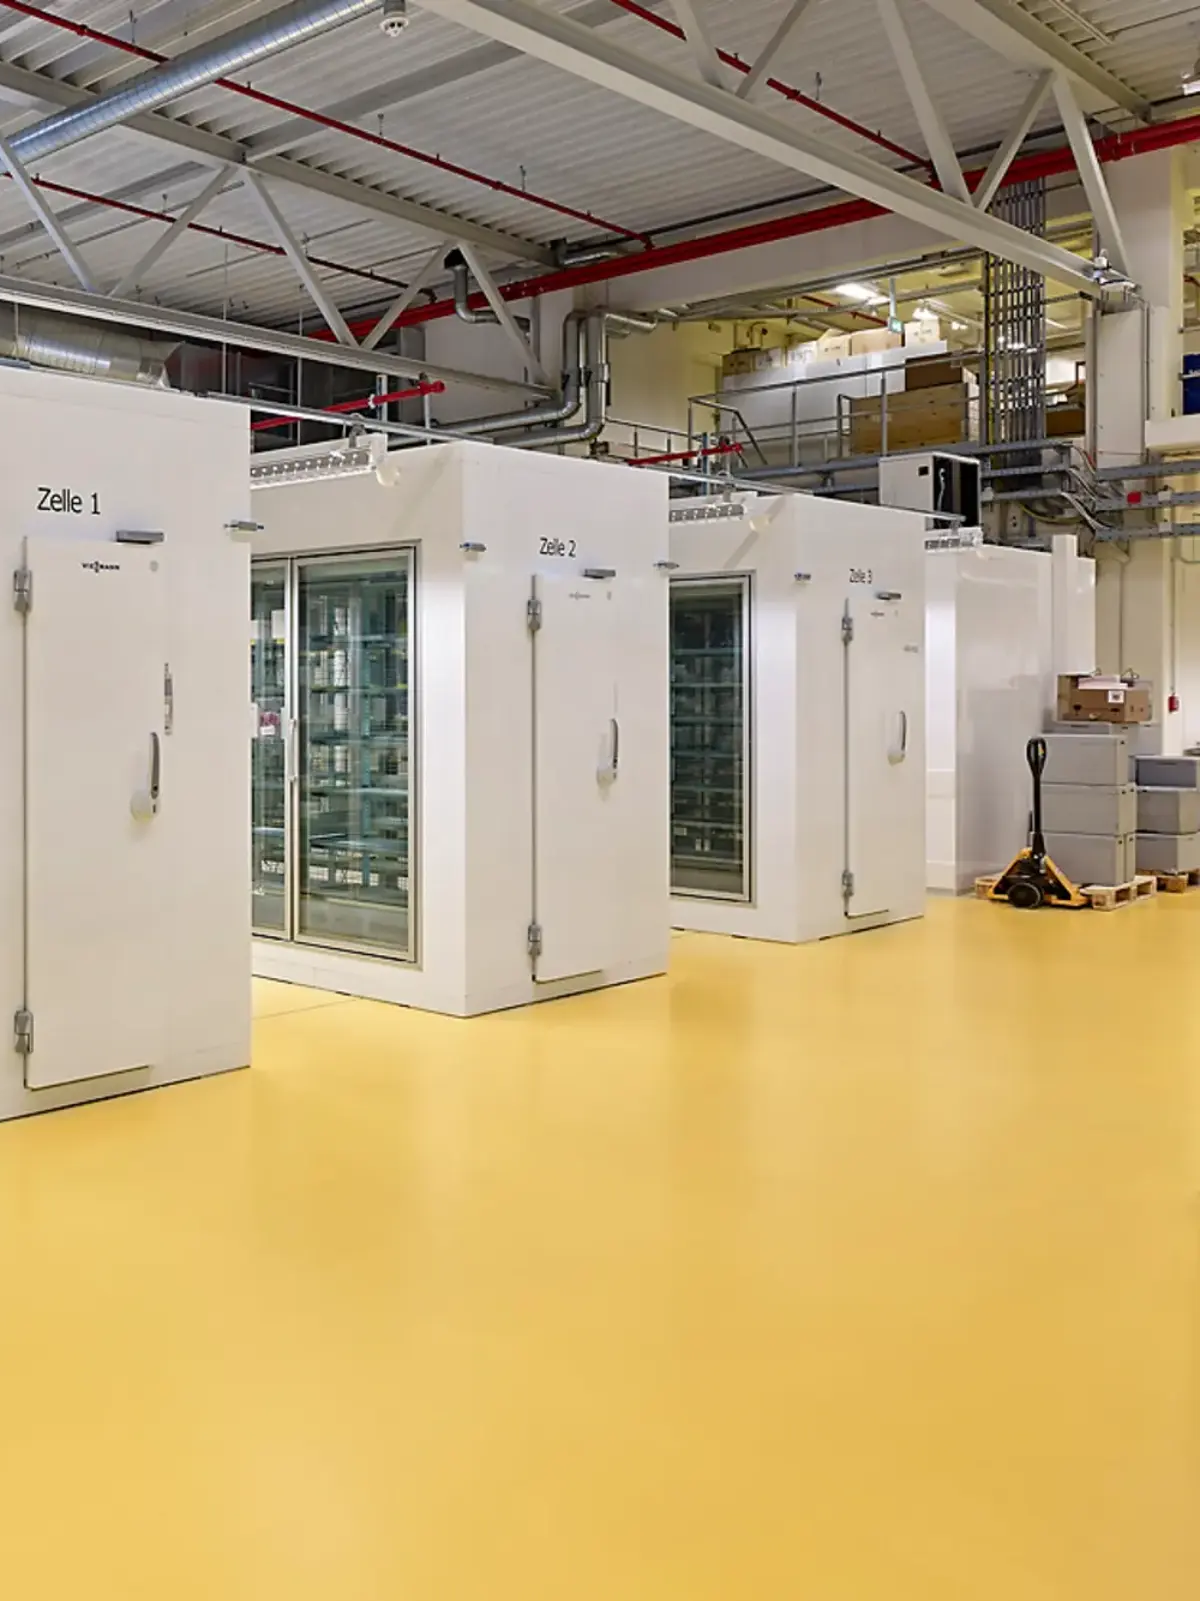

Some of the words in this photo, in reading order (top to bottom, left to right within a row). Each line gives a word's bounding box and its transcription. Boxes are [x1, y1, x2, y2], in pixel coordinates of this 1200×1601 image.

[37, 487, 83, 514] Zelle
[91, 492, 101, 515] 1
[539, 537, 565, 557] Zelle
[568, 540, 577, 558] 2
